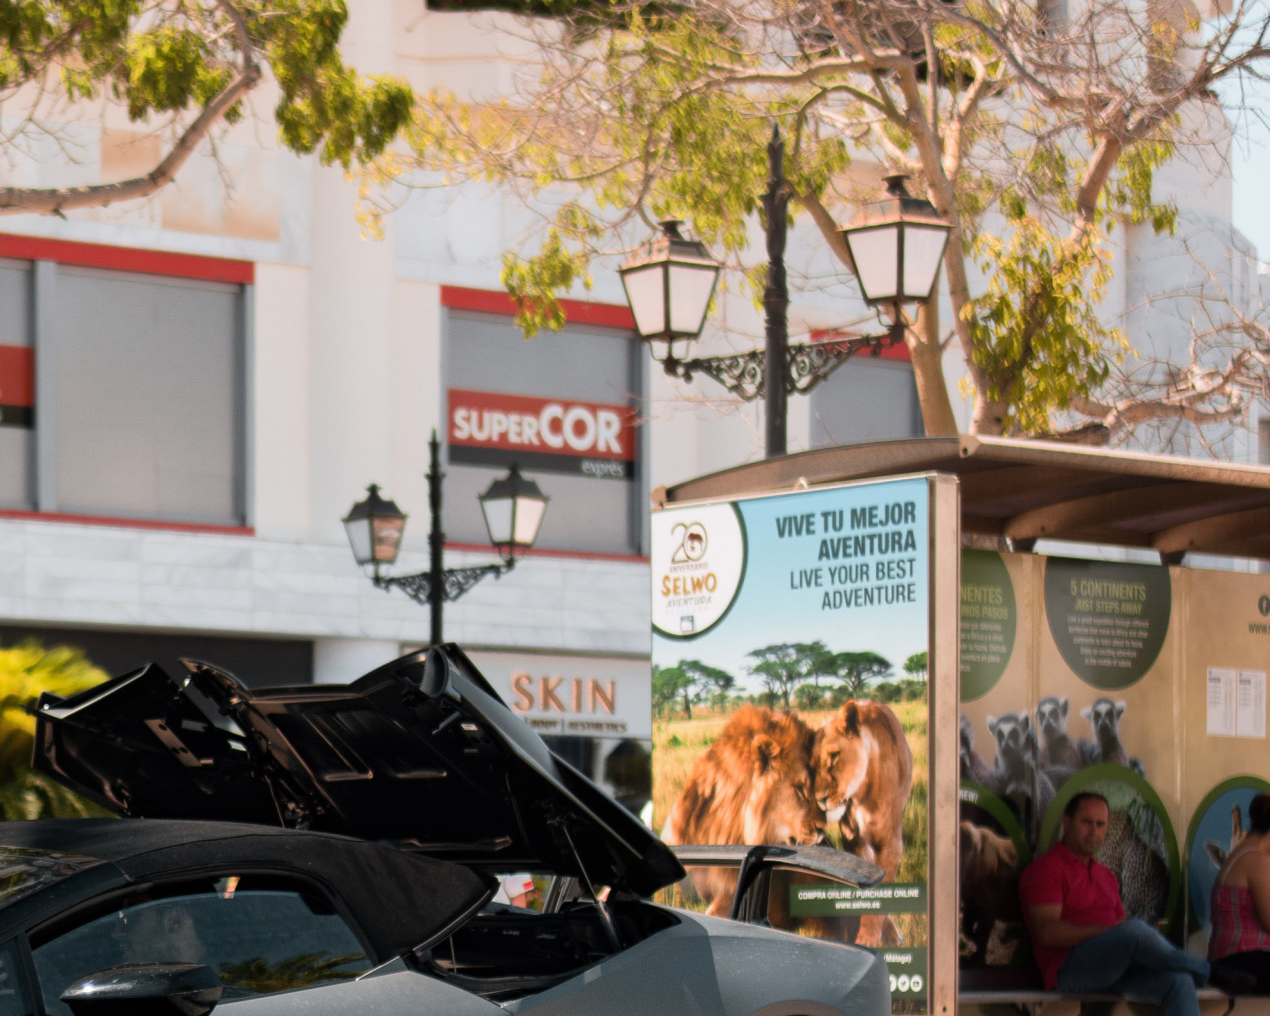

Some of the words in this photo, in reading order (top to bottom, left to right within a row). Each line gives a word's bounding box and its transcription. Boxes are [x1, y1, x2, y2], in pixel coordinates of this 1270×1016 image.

[452, 403, 623, 454] SUPERCOR
[776, 513, 816, 539] VIVE
[821, 509, 844, 534] TU
[850, 501, 917, 529] MEJOR
[817, 529, 917, 562] AVENTURA
[661, 571, 718, 598] SELWO
[789, 567, 823, 590] LIVE
[828, 563, 870, 586] YOUR
[875, 557, 917, 581] BEST
[665, 595, 713, 609] AVENTURA
[821, 582, 917, 611] ADVENTURE
[960, 583, 1003, 604] NENTES
[1069, 578, 1078, 597] 5
[1080, 579, 1147, 602] CONTINENTS
[511, 671, 617, 715] SKIN
[798, 889, 826, 900] COMPRA
[827, 888, 852, 900] ONLINE
[856, 887, 893, 899] PURCHASE
[894, 887, 919, 898] ONLINE
